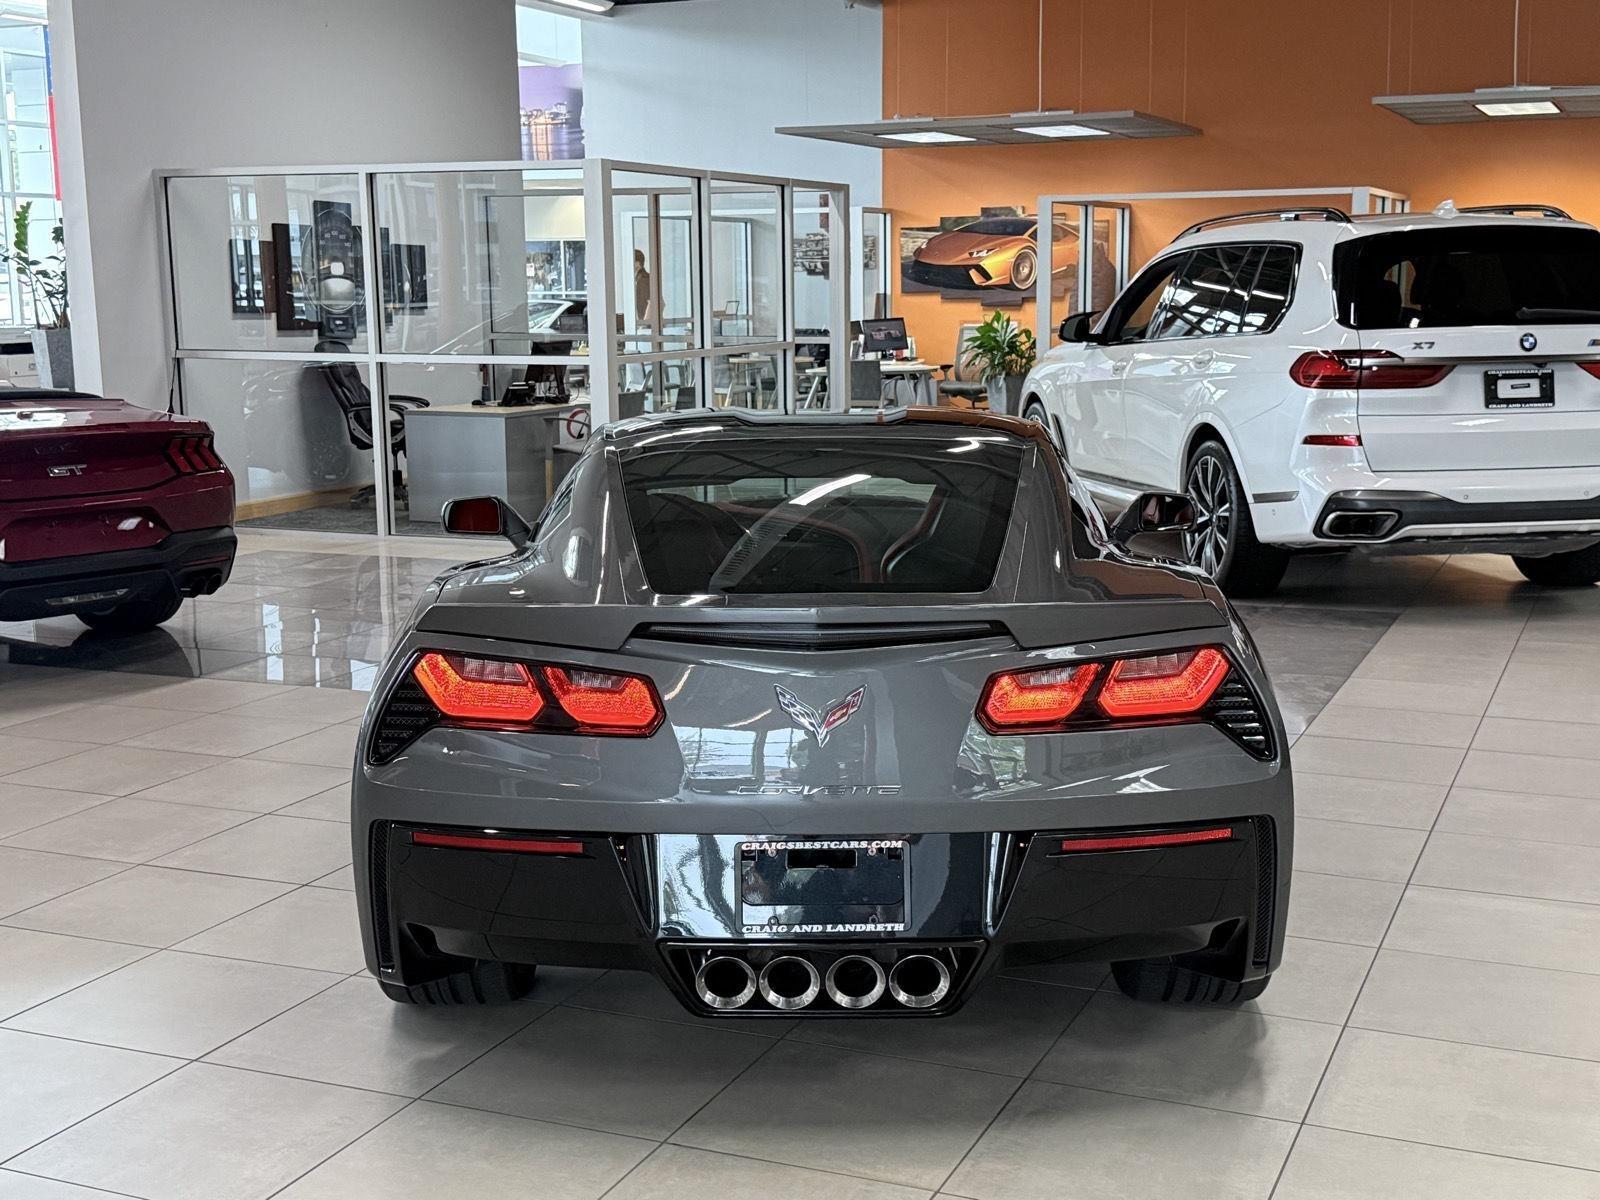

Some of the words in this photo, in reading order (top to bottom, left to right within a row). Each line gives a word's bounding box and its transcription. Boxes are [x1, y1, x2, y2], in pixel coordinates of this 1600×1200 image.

[1412, 341, 1435, 350] X7
[47, 464, 87, 476] GT
[737, 785, 902, 795] CORVETTE
[741, 840, 903, 850] CRAIGSBESTCARS.COM
[742, 924, 788, 933] CRAIG
[790, 924, 823, 933] AND
[825, 923, 905, 932] LANDRETH
